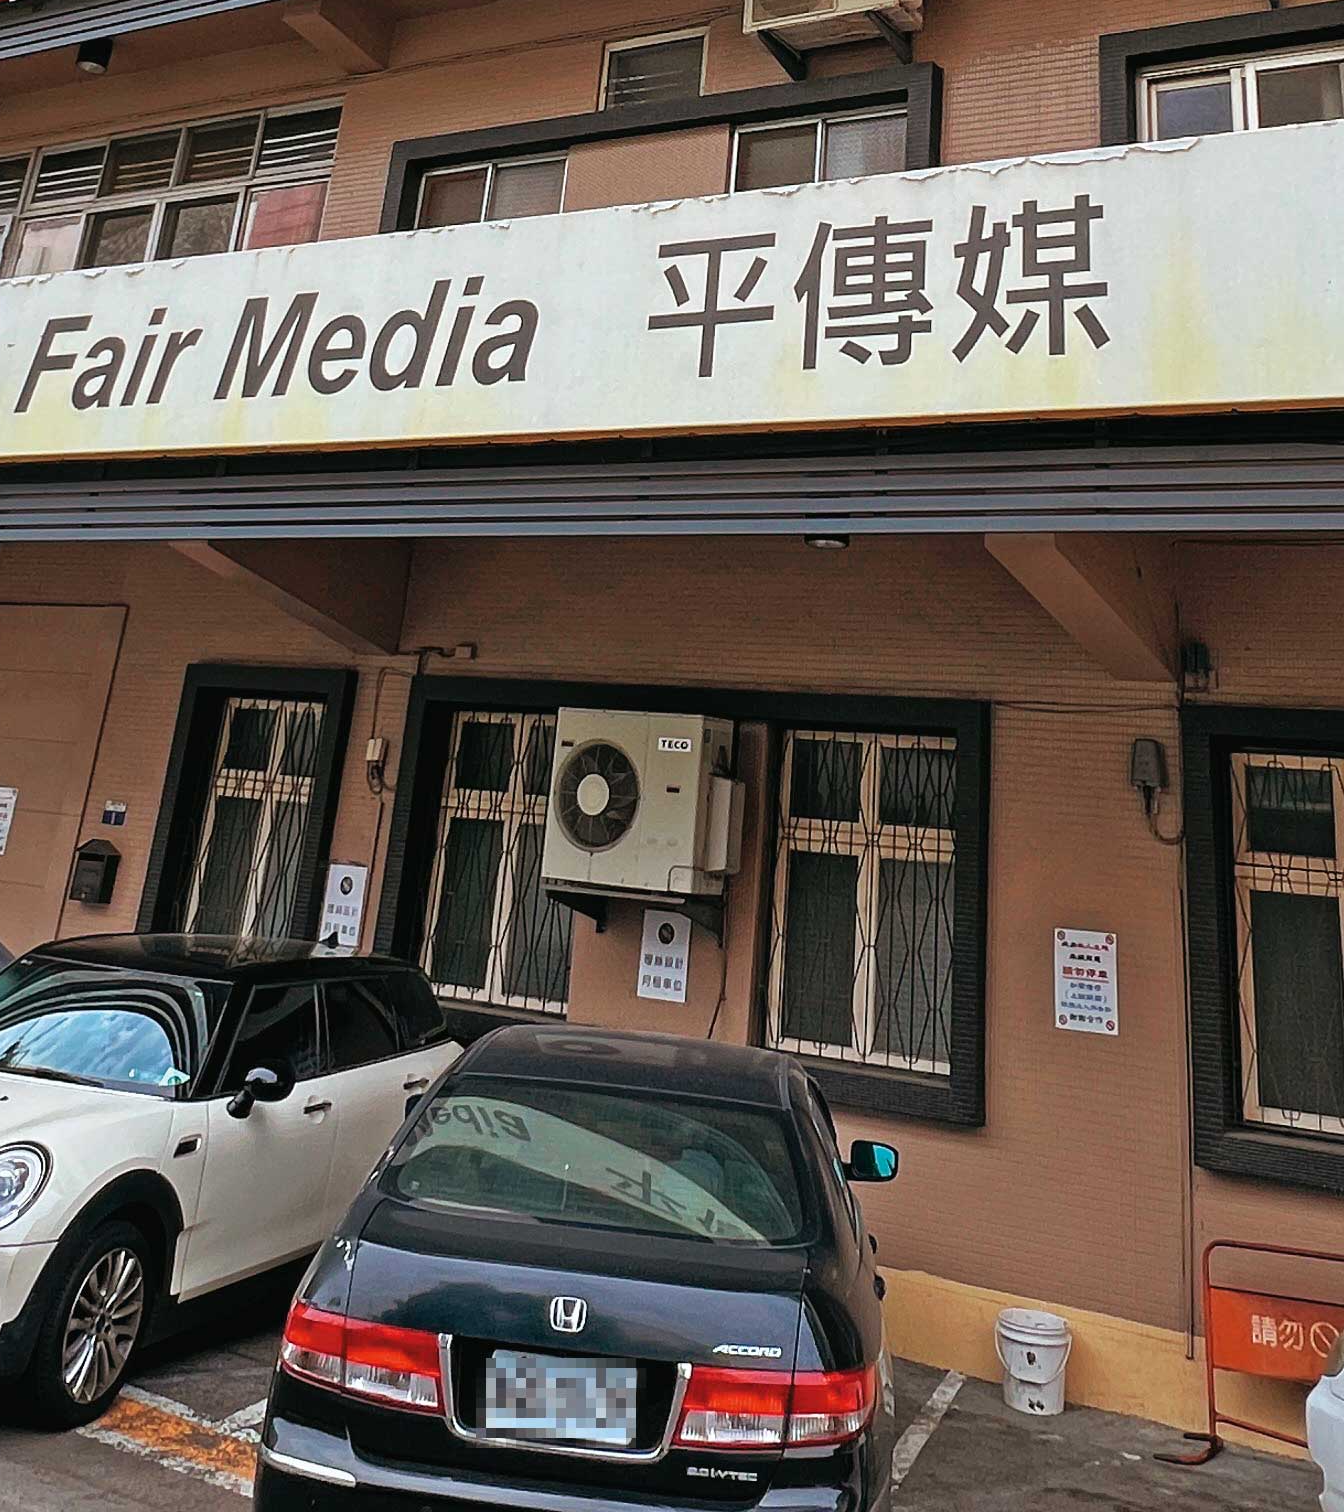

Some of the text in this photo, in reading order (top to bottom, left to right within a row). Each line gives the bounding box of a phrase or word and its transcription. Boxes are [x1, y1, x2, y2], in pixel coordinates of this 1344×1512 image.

[12, 306, 203, 415] Fair
[213, 275, 541, 401] Media
[647, 193, 1111, 378] 平傳媒
[661, 739, 689, 750] TECO
[1251, 1314, 1304, 1351] 請勿
[712, 1344, 783, 1358] ACCORD
